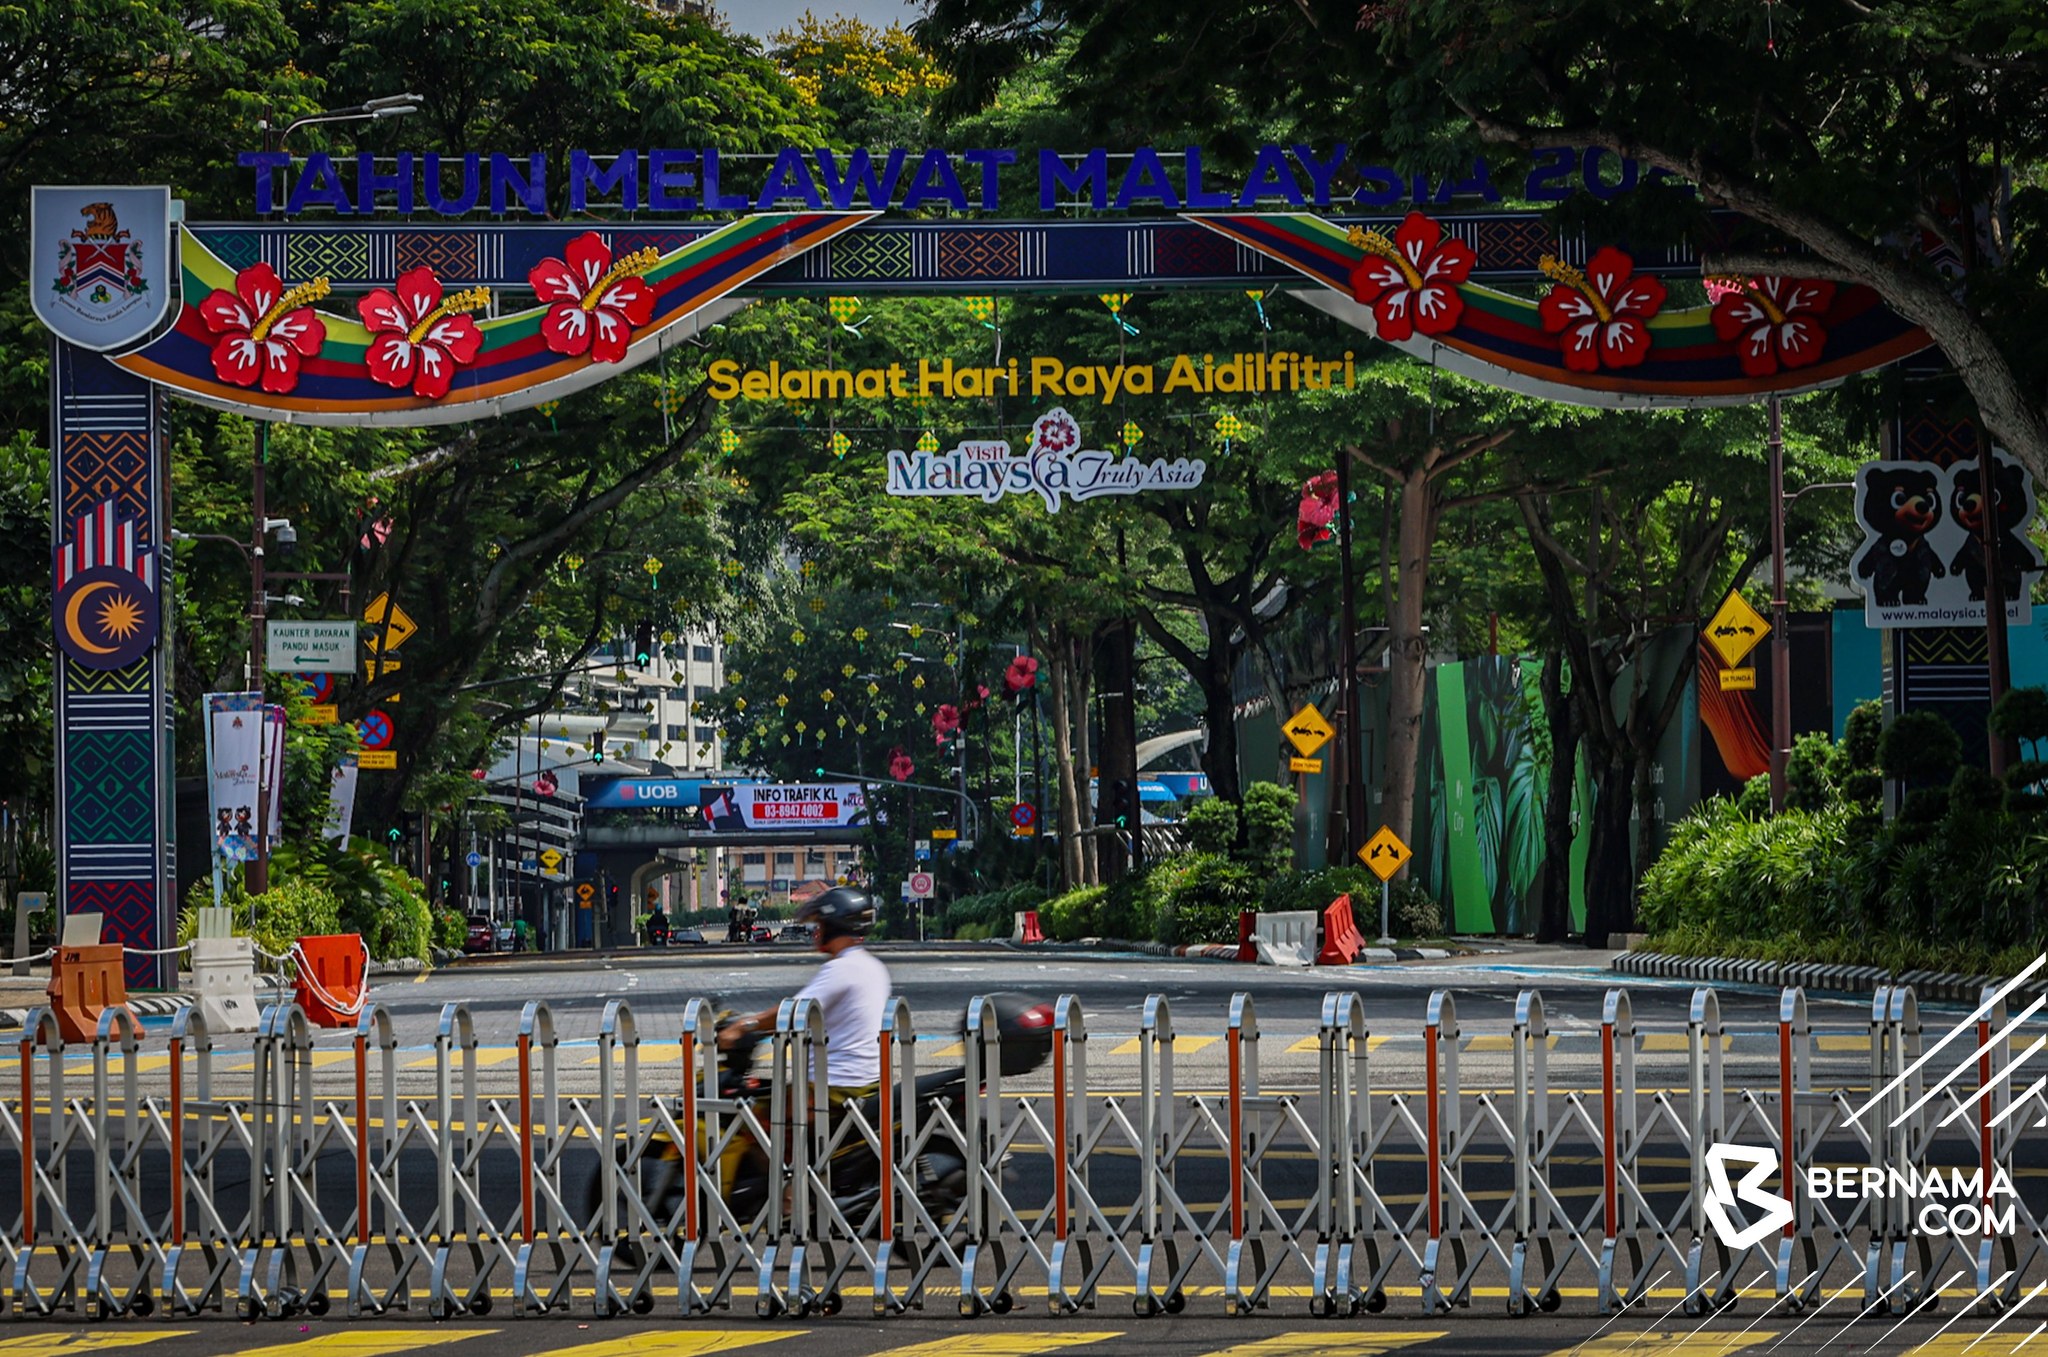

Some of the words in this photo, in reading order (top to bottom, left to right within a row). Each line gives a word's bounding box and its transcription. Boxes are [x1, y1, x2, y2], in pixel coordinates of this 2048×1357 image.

[237, 151, 547, 215] TAHUN
[569, 147, 1017, 211] MELAWAT
[706, 358, 908, 400] Selamat
[918, 357, 1019, 398] Hari
[1030, 356, 1154, 405] Raya
[1161, 350, 1355, 394] Aidilfitri
[963, 445, 1005, 461] Visit
[892, 451, 1070, 500] Malaysia
[1076, 456, 1144, 490] Truly
[1147, 459, 1198, 484] Asia
[273, 628, 310, 638] KAUNTER
[314, 628, 350, 638] BAYARAN
[282, 641, 309, 651] PANDU
[312, 641, 340, 651] MASUK
[638, 785, 678, 799] UOB
[753, 788, 782, 802] INFO
[783, 787, 821, 802] TRAFIK
[823, 787, 838, 801] KL
[764, 804, 800, 818] 03-8947
[801, 803, 824, 818] 4002
